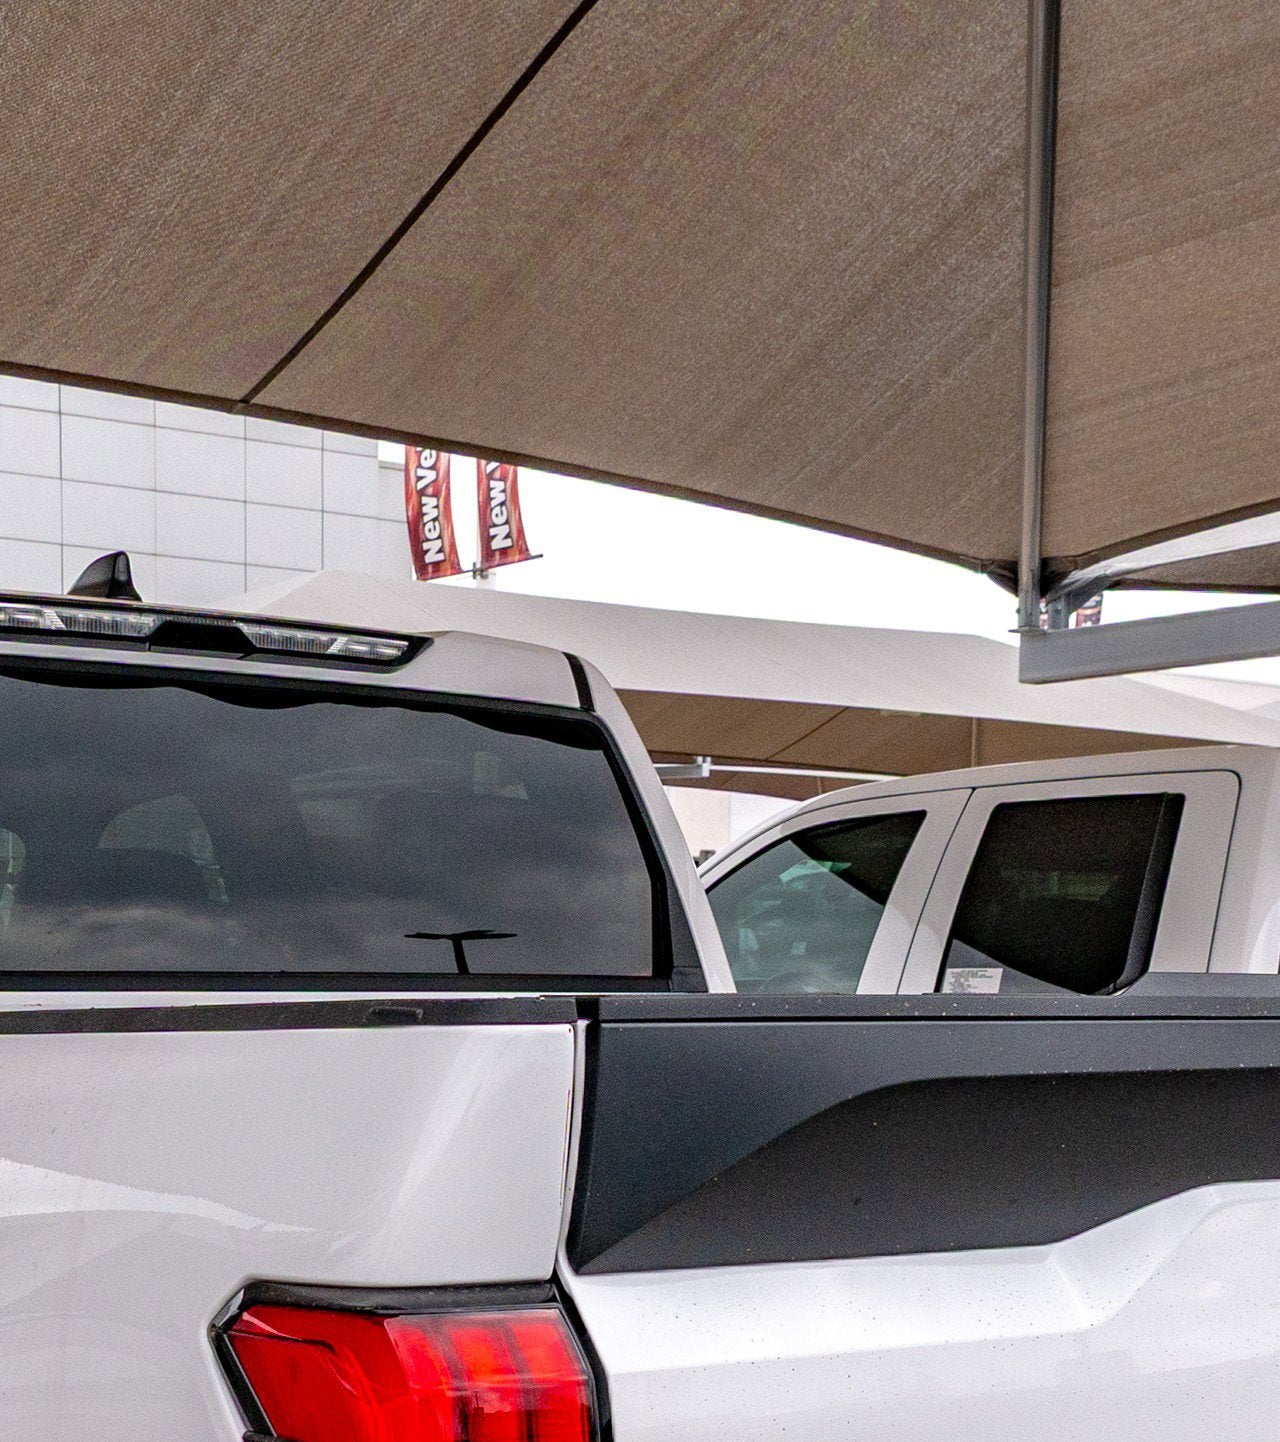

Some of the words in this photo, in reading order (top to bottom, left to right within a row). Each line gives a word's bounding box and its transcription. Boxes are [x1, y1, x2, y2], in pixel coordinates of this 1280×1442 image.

[416, 448, 437, 491] Ve
[421, 496, 445, 564] New
[488, 480, 513, 551] New
